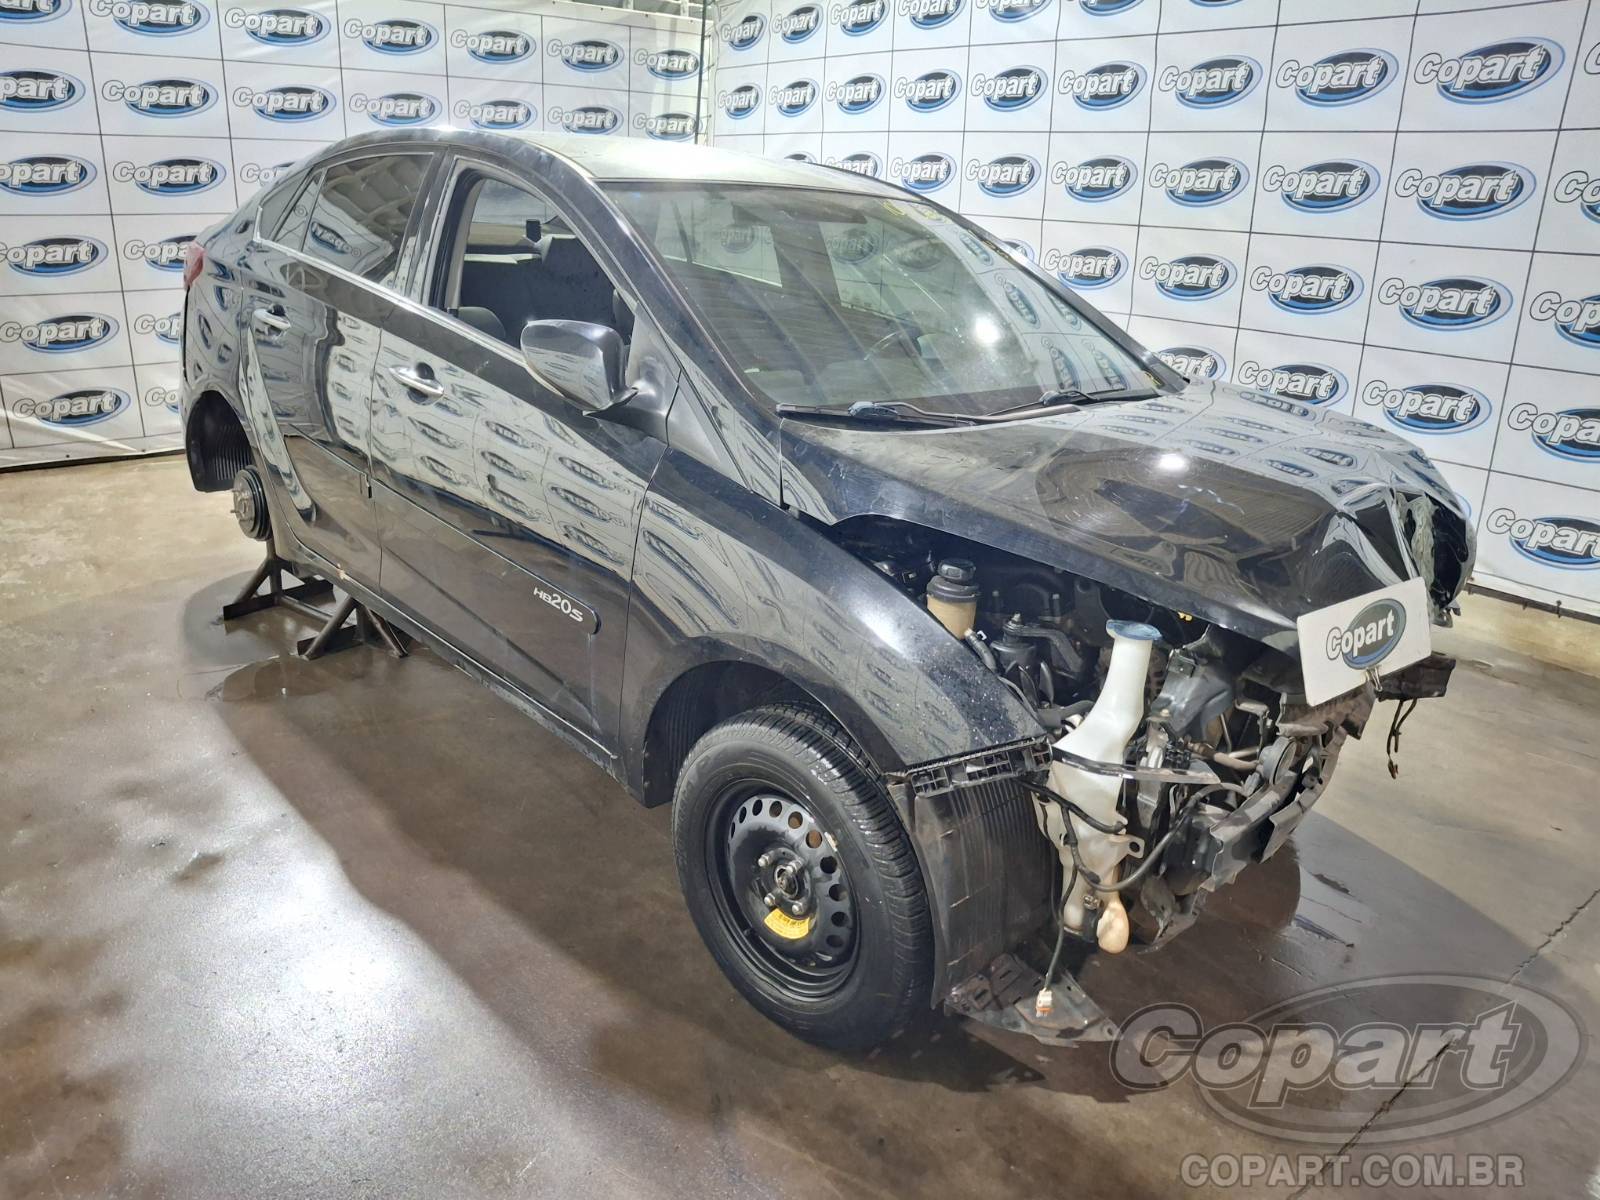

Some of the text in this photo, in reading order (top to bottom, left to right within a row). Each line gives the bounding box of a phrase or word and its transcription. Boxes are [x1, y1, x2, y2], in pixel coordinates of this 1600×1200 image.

[89, 0, 194, 26] Copart
[225, 8, 320, 36] Copart
[831, 0, 885, 28] Copart
[344, 18, 428, 46] Copart
[450, 29, 527, 55] Copart
[547, 39, 615, 65] Copart
[634, 49, 695, 73] Copart
[1059, 66, 1136, 100] Copart
[1159, 61, 1249, 99] Copart
[1276, 55, 1383, 95] Copart
[1414, 44, 1545, 92] Copart
[0, 77, 69, 102] part
[102, 80, 205, 109] Copart
[233, 87, 325, 114] Copart
[718, 88, 757, 112] Copart
[769, 82, 814, 108] Copart
[825, 76, 880, 110] Copart
[895, 73, 954, 104] Copart
[971, 71, 1039, 102] Copart
[349, 93, 430, 119] Copart
[453, 99, 529, 123] Copart
[548, 107, 615, 129] Copart
[632, 112, 695, 135] Copart
[0, 160, 82, 188] opart
[113, 161, 213, 188] Copart
[890, 156, 948, 183] Copart
[965, 159, 1032, 187] Copart
[1051, 160, 1128, 190] Copart
[1149, 163, 1238, 196] Copart
[1263, 165, 1365, 200] Copart
[1395, 168, 1518, 207] Copart
[124, 240, 188, 265] Copa
[1044, 249, 1118, 280] Copart
[1140, 256, 1226, 290] Copart
[1250, 266, 1351, 301] Copart
[1378, 278, 1496, 317] Copart
[1530, 291, 1600, 334] Cop
[0, 316, 104, 347] Copart
[1238, 361, 1335, 399] Copart
[13, 391, 116, 420] Copart
[1362, 380, 1476, 422] Copart
[1508, 403, 1600, 445] Copa
[1487, 508, 1600, 557] Copar
[533, 587, 584, 622] HB20S
[1326, 609, 1395, 661] Copart
